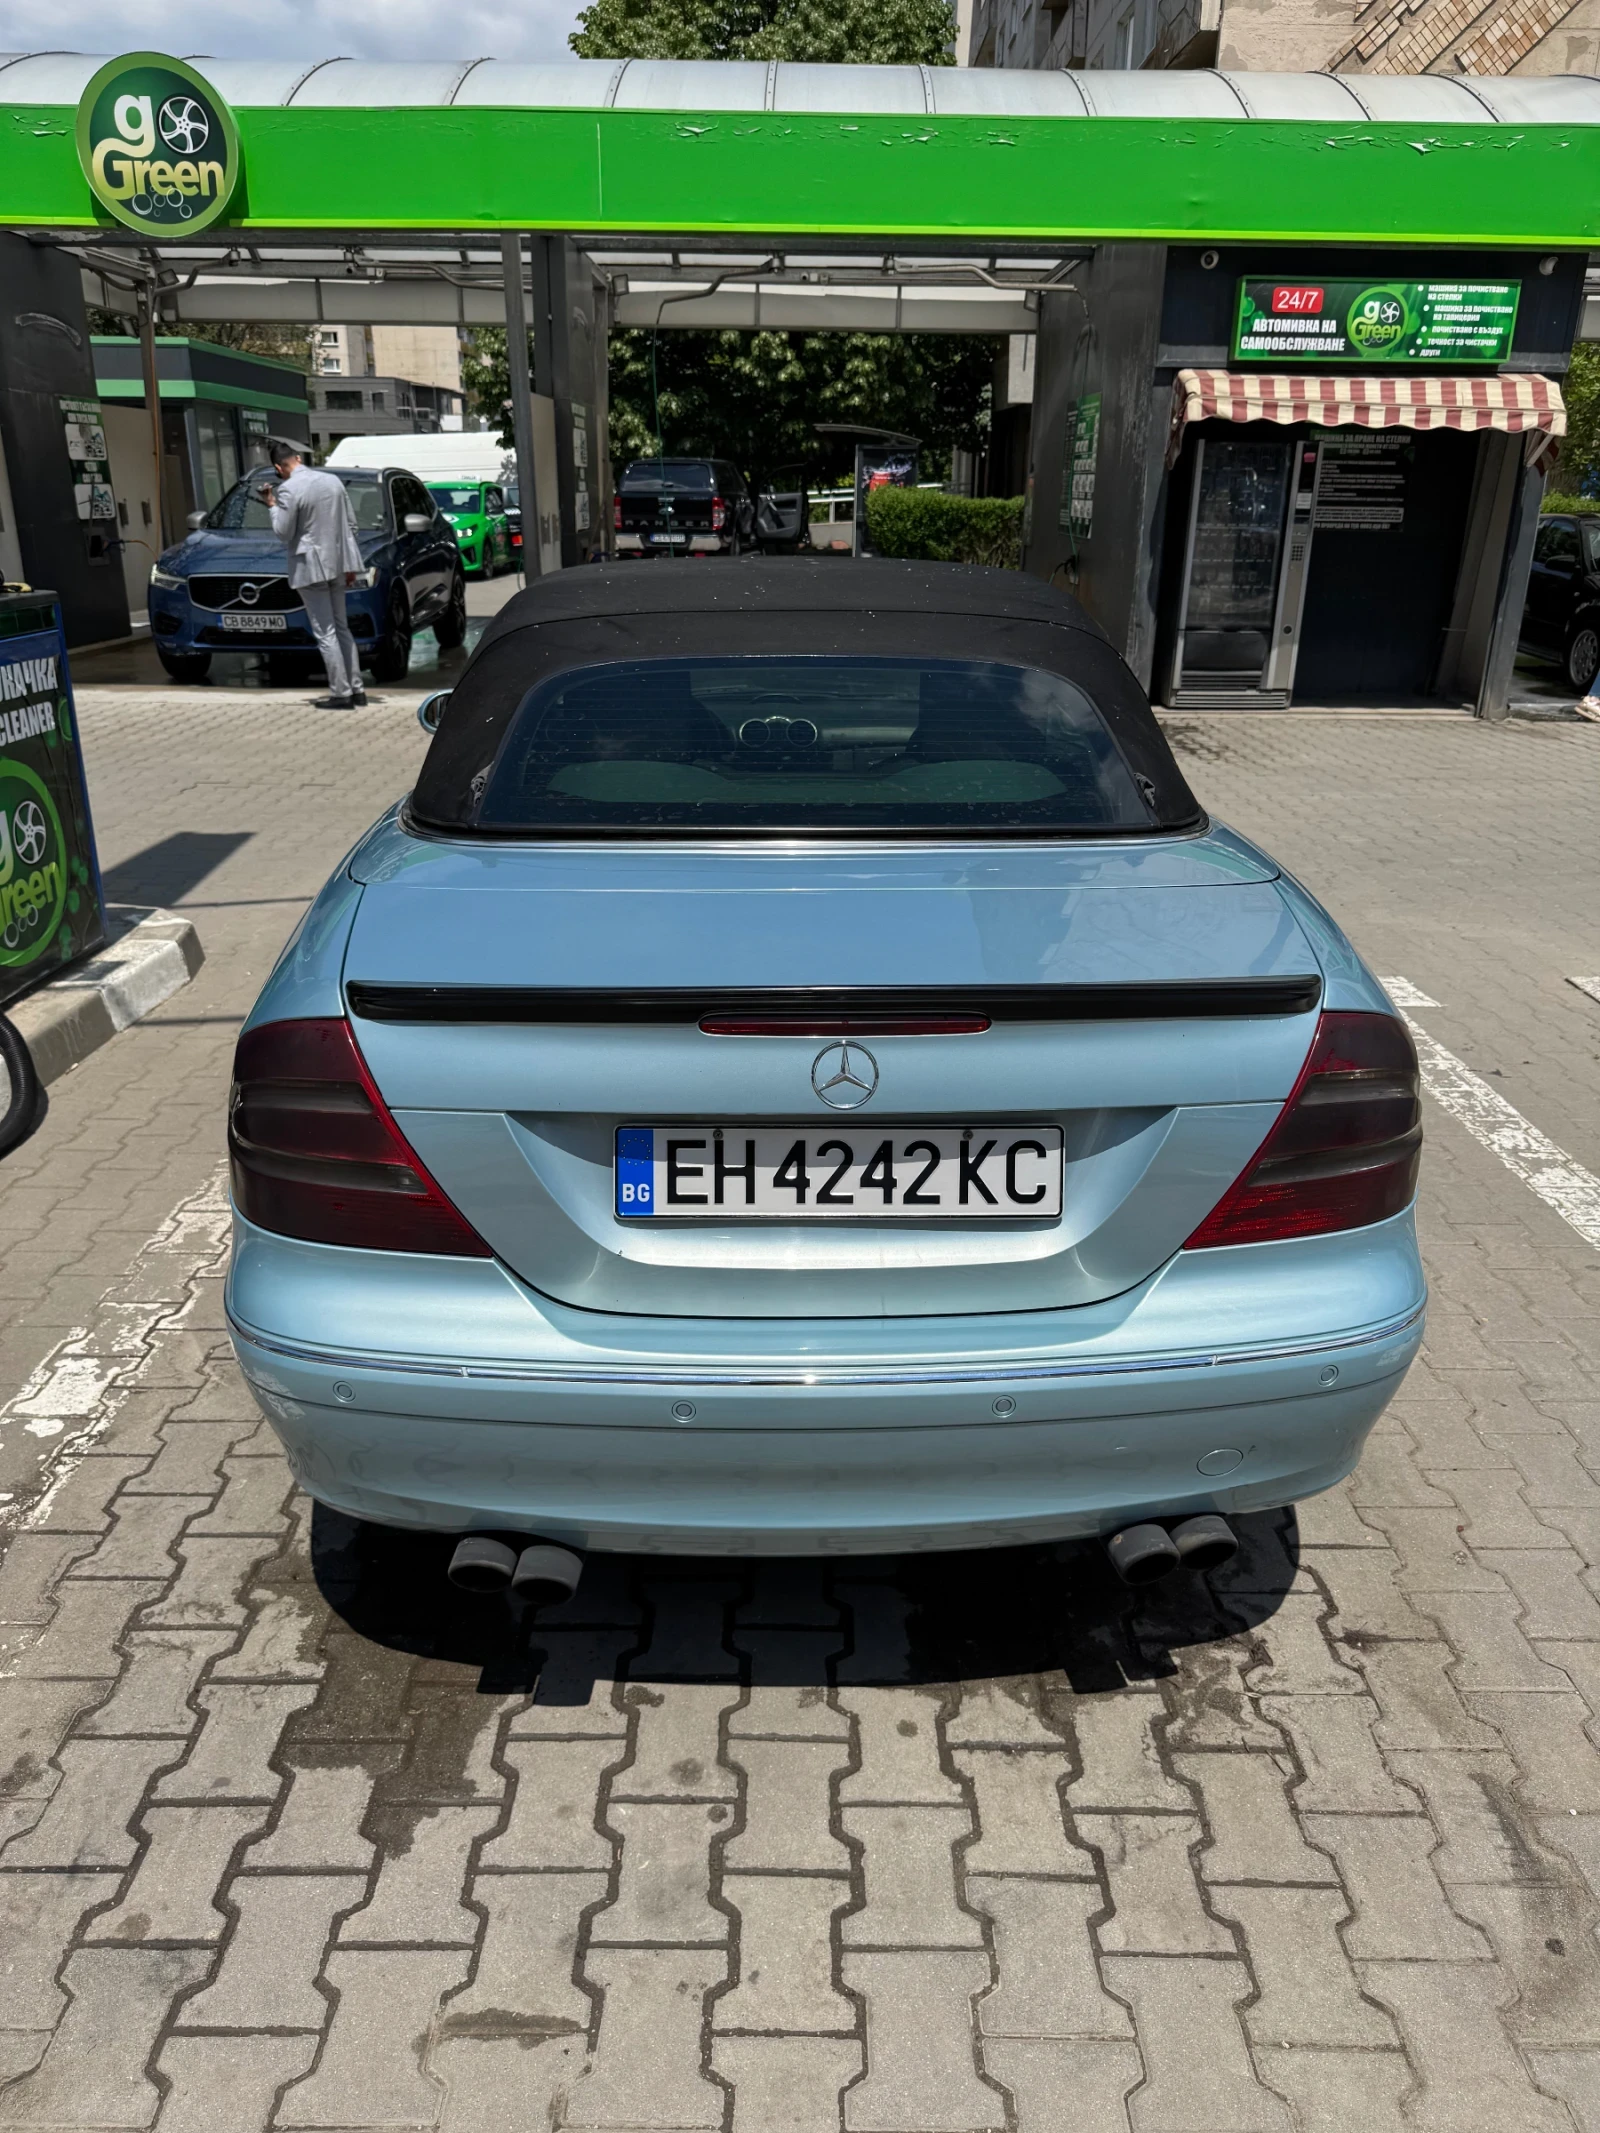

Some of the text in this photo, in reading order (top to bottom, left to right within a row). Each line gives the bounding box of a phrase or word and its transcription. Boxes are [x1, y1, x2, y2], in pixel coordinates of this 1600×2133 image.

[92, 148, 226, 201] Green
[1276, 290, 1319, 310] 24/7
[1252, 319, 1337, 334] АВТОМИВКА НА
[1351, 320, 1402, 342] Green
[1240, 336, 1346, 351] САМООБСЛУЖВАНЕ
[624, 519, 711, 527] RANGER
[224, 616, 239, 627] CB
[240, 616, 267, 628] 8849
[0, 656, 58, 704] КАЧКА
[0, 861, 61, 926] reen
[666, 1139, 1048, 1205] EH 4242 KC
[622, 1184, 650, 1203] BG
